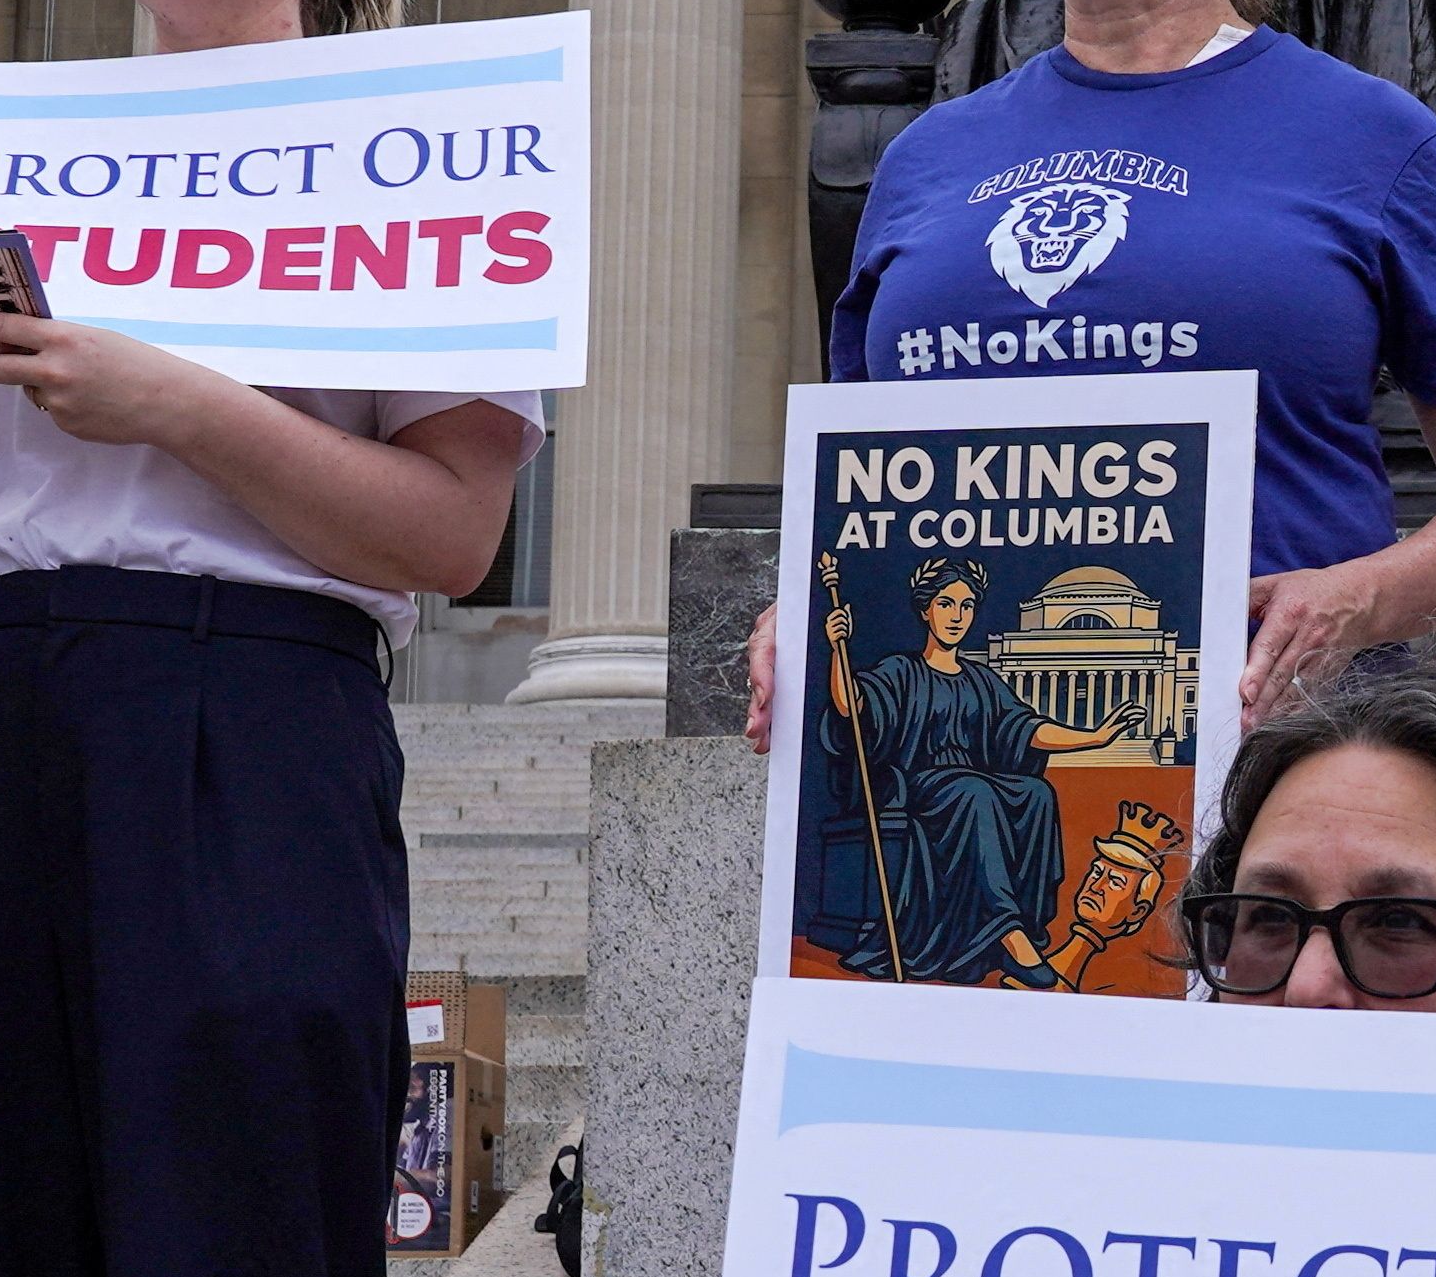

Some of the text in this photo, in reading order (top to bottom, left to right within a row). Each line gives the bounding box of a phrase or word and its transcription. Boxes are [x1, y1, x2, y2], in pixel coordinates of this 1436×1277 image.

[362, 123, 556, 189] OUR
[967, 149, 1190, 205] COLUMBIA
[897, 314, 1200, 376] #NoKings
[835, 439, 1179, 504] NO KINGS
[835, 504, 1175, 551] AT COLUMBIA
